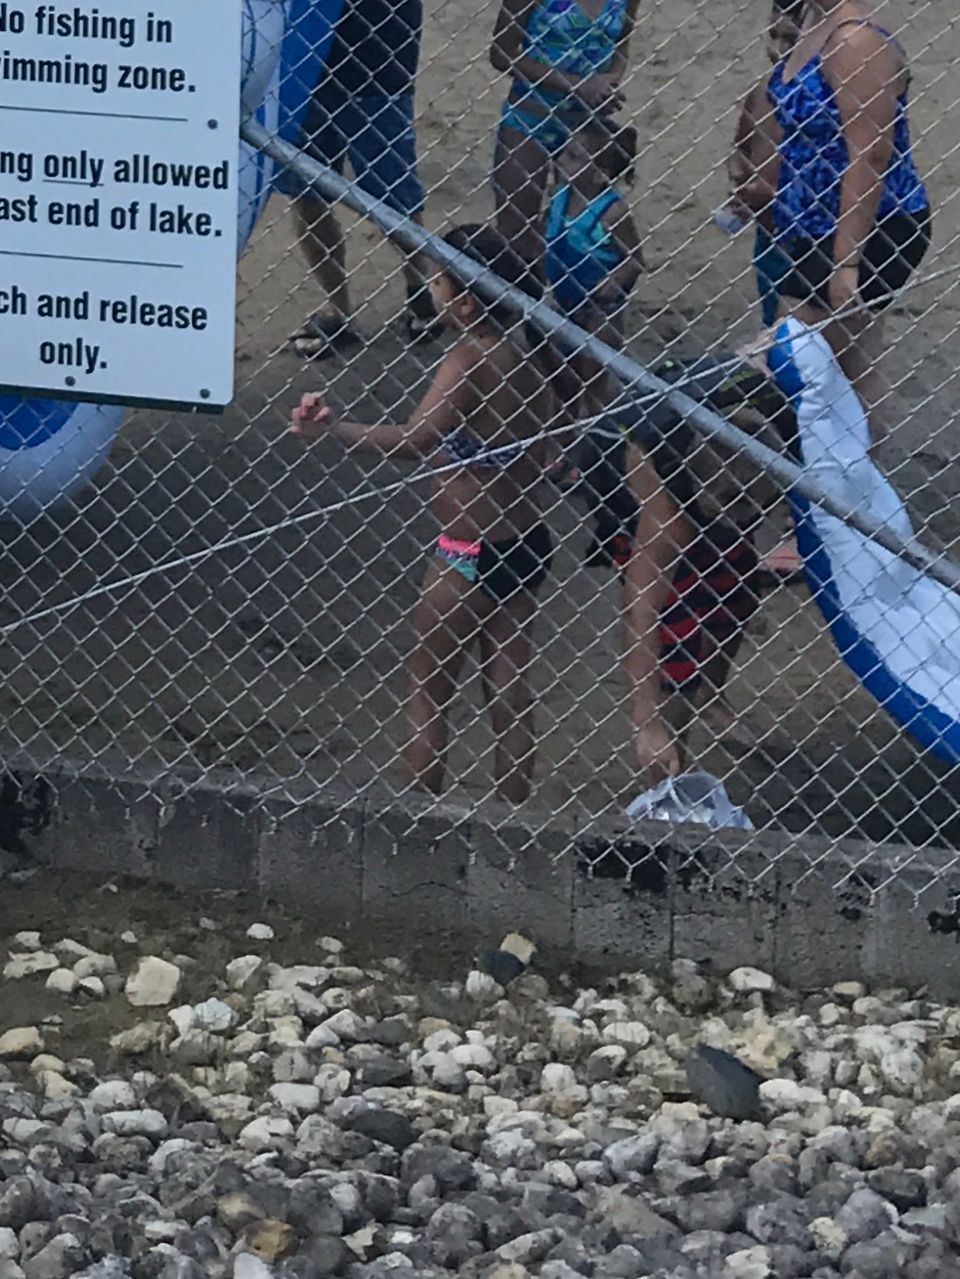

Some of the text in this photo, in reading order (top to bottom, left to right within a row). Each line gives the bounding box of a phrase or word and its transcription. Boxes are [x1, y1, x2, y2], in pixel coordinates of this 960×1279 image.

[34, 5, 136, 48] fishing
[146, 11, 172, 44] in
[118, 65, 196, 93] zone.
[43, 150, 104, 187] only
[113, 153, 229, 190] allowed
[48, 199, 100, 228] end
[110, 200, 140, 231] of
[149, 202, 222, 237] lake.
[37, 290, 89, 321] and
[99, 294, 208, 331] release
[39, 337, 107, 375] only.
